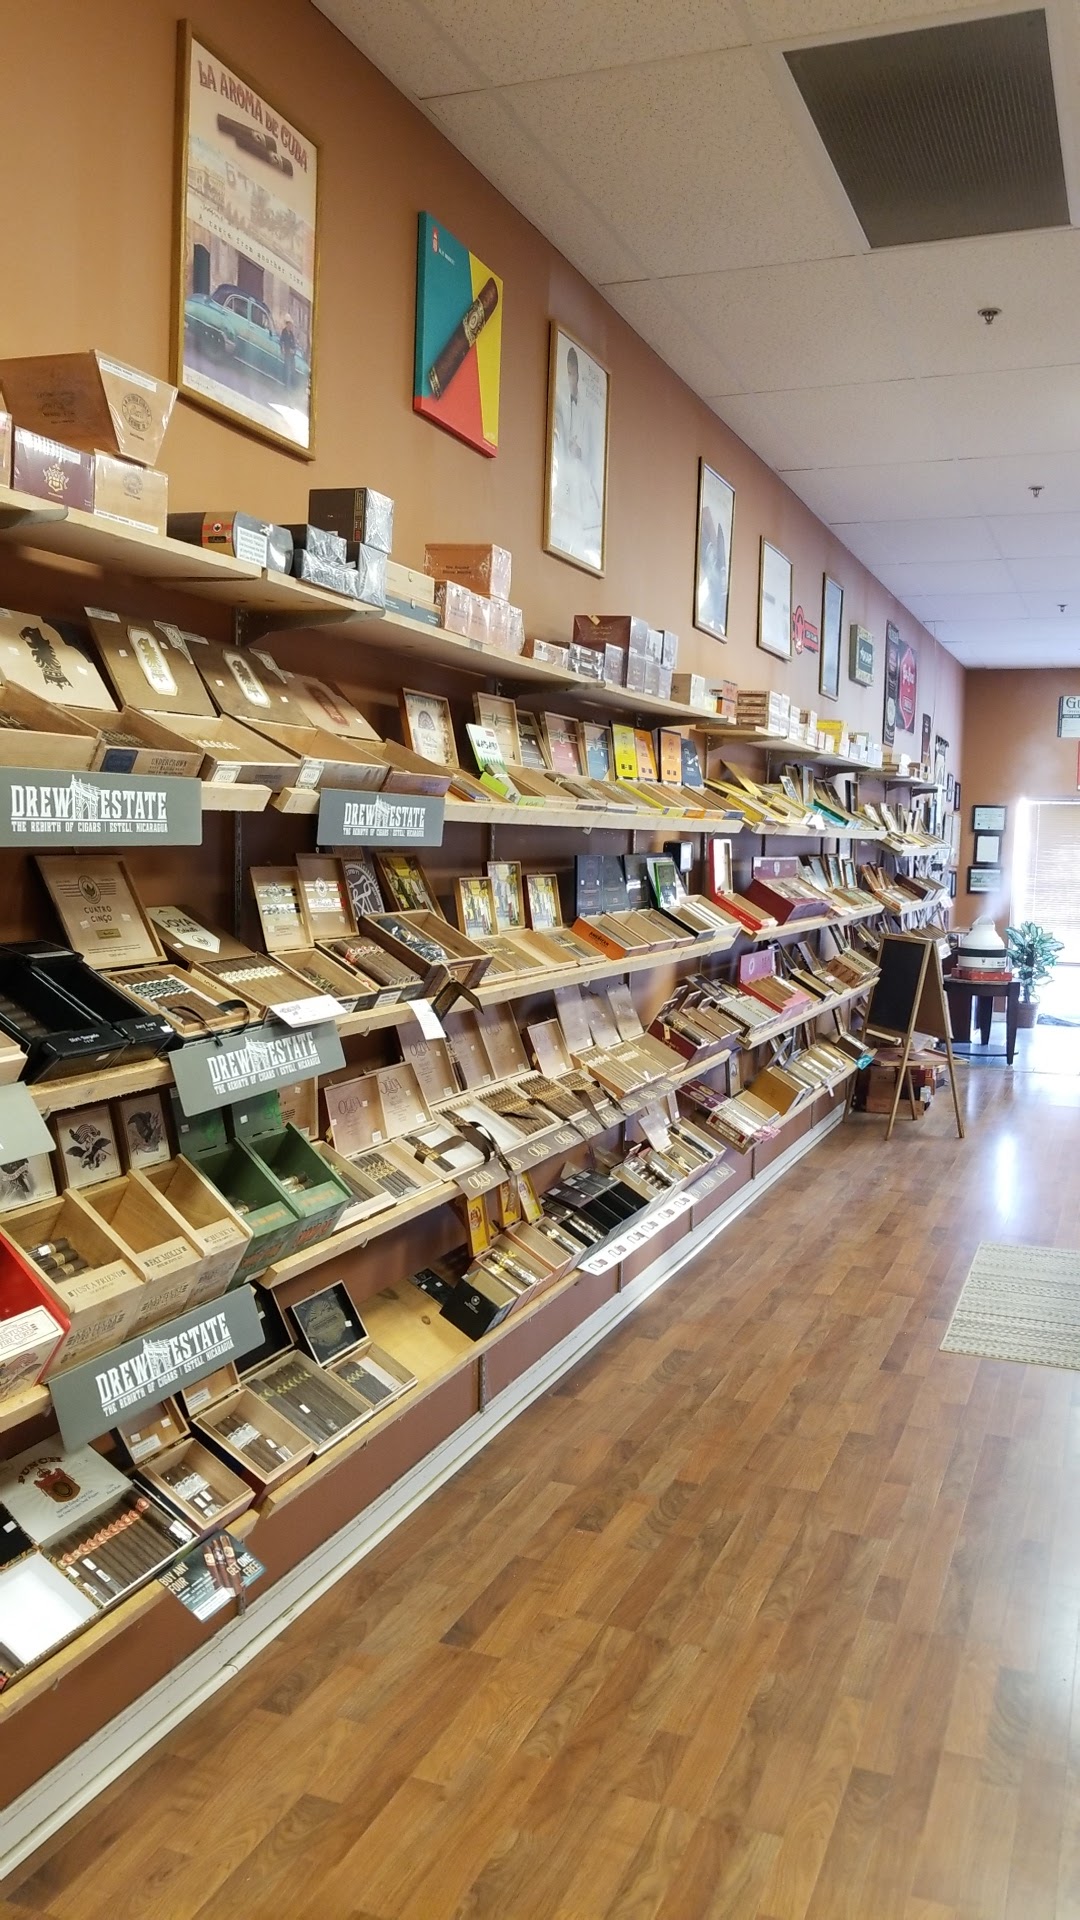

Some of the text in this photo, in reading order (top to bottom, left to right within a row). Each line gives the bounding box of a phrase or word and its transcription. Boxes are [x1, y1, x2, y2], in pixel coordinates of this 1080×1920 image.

[198, 60, 308, 173] LA AROMA DE CUBA
[10, 785, 167, 819] DREW ESTATE
[343, 802, 426, 827] DREW ESTATE
[11, 821, 27, 832] THE
[30, 821, 61, 832] REBIRTH
[65, 821, 74, 832] OF
[77, 821, 101, 833] CIGARS
[136, 823, 168, 833] NICARAGUA
[83, 905, 112, 914] CUATRO
[162, 918, 198, 928] JOYA
[206, 1031, 318, 1082] DREW ESTATE
[213, 1085, 226, 1095] THE
[227, 1077, 250, 1091] REBIRTH
[250, 1075, 257, 1084] OF
[258, 1069, 276, 1082] CIGARS
[297, 1056, 321, 1071] NICARAGUA
[467, 1168, 495, 1190] OLIVA
[206, 1228, 232, 1241] CHUNKY
[148, 1257, 162, 1267] FAT
[161, 1248, 182, 1261] MOLLY
[72, 1283, 91, 1297] JUST
[95, 1271, 122, 1286] FRIEND
[95, 1352, 150, 1404] DREW
[168, 1311, 231, 1365] ESTATE
[103, 1404, 118, 1417] THE
[119, 1388, 146, 1409] REBIRTH
[147, 1381, 155, 1394] OF
[157, 1369, 178, 1388] CIGARS
[205, 1339, 235, 1361] NICARAGUA
[18, 1456, 63, 1484] PUNCH
[159, 1561, 189, 1587] BUY ANY
[226, 1552, 254, 1576] GET ONE
[242, 1560, 262, 1577] FREE
[167, 1576, 189, 1595] FOUR
